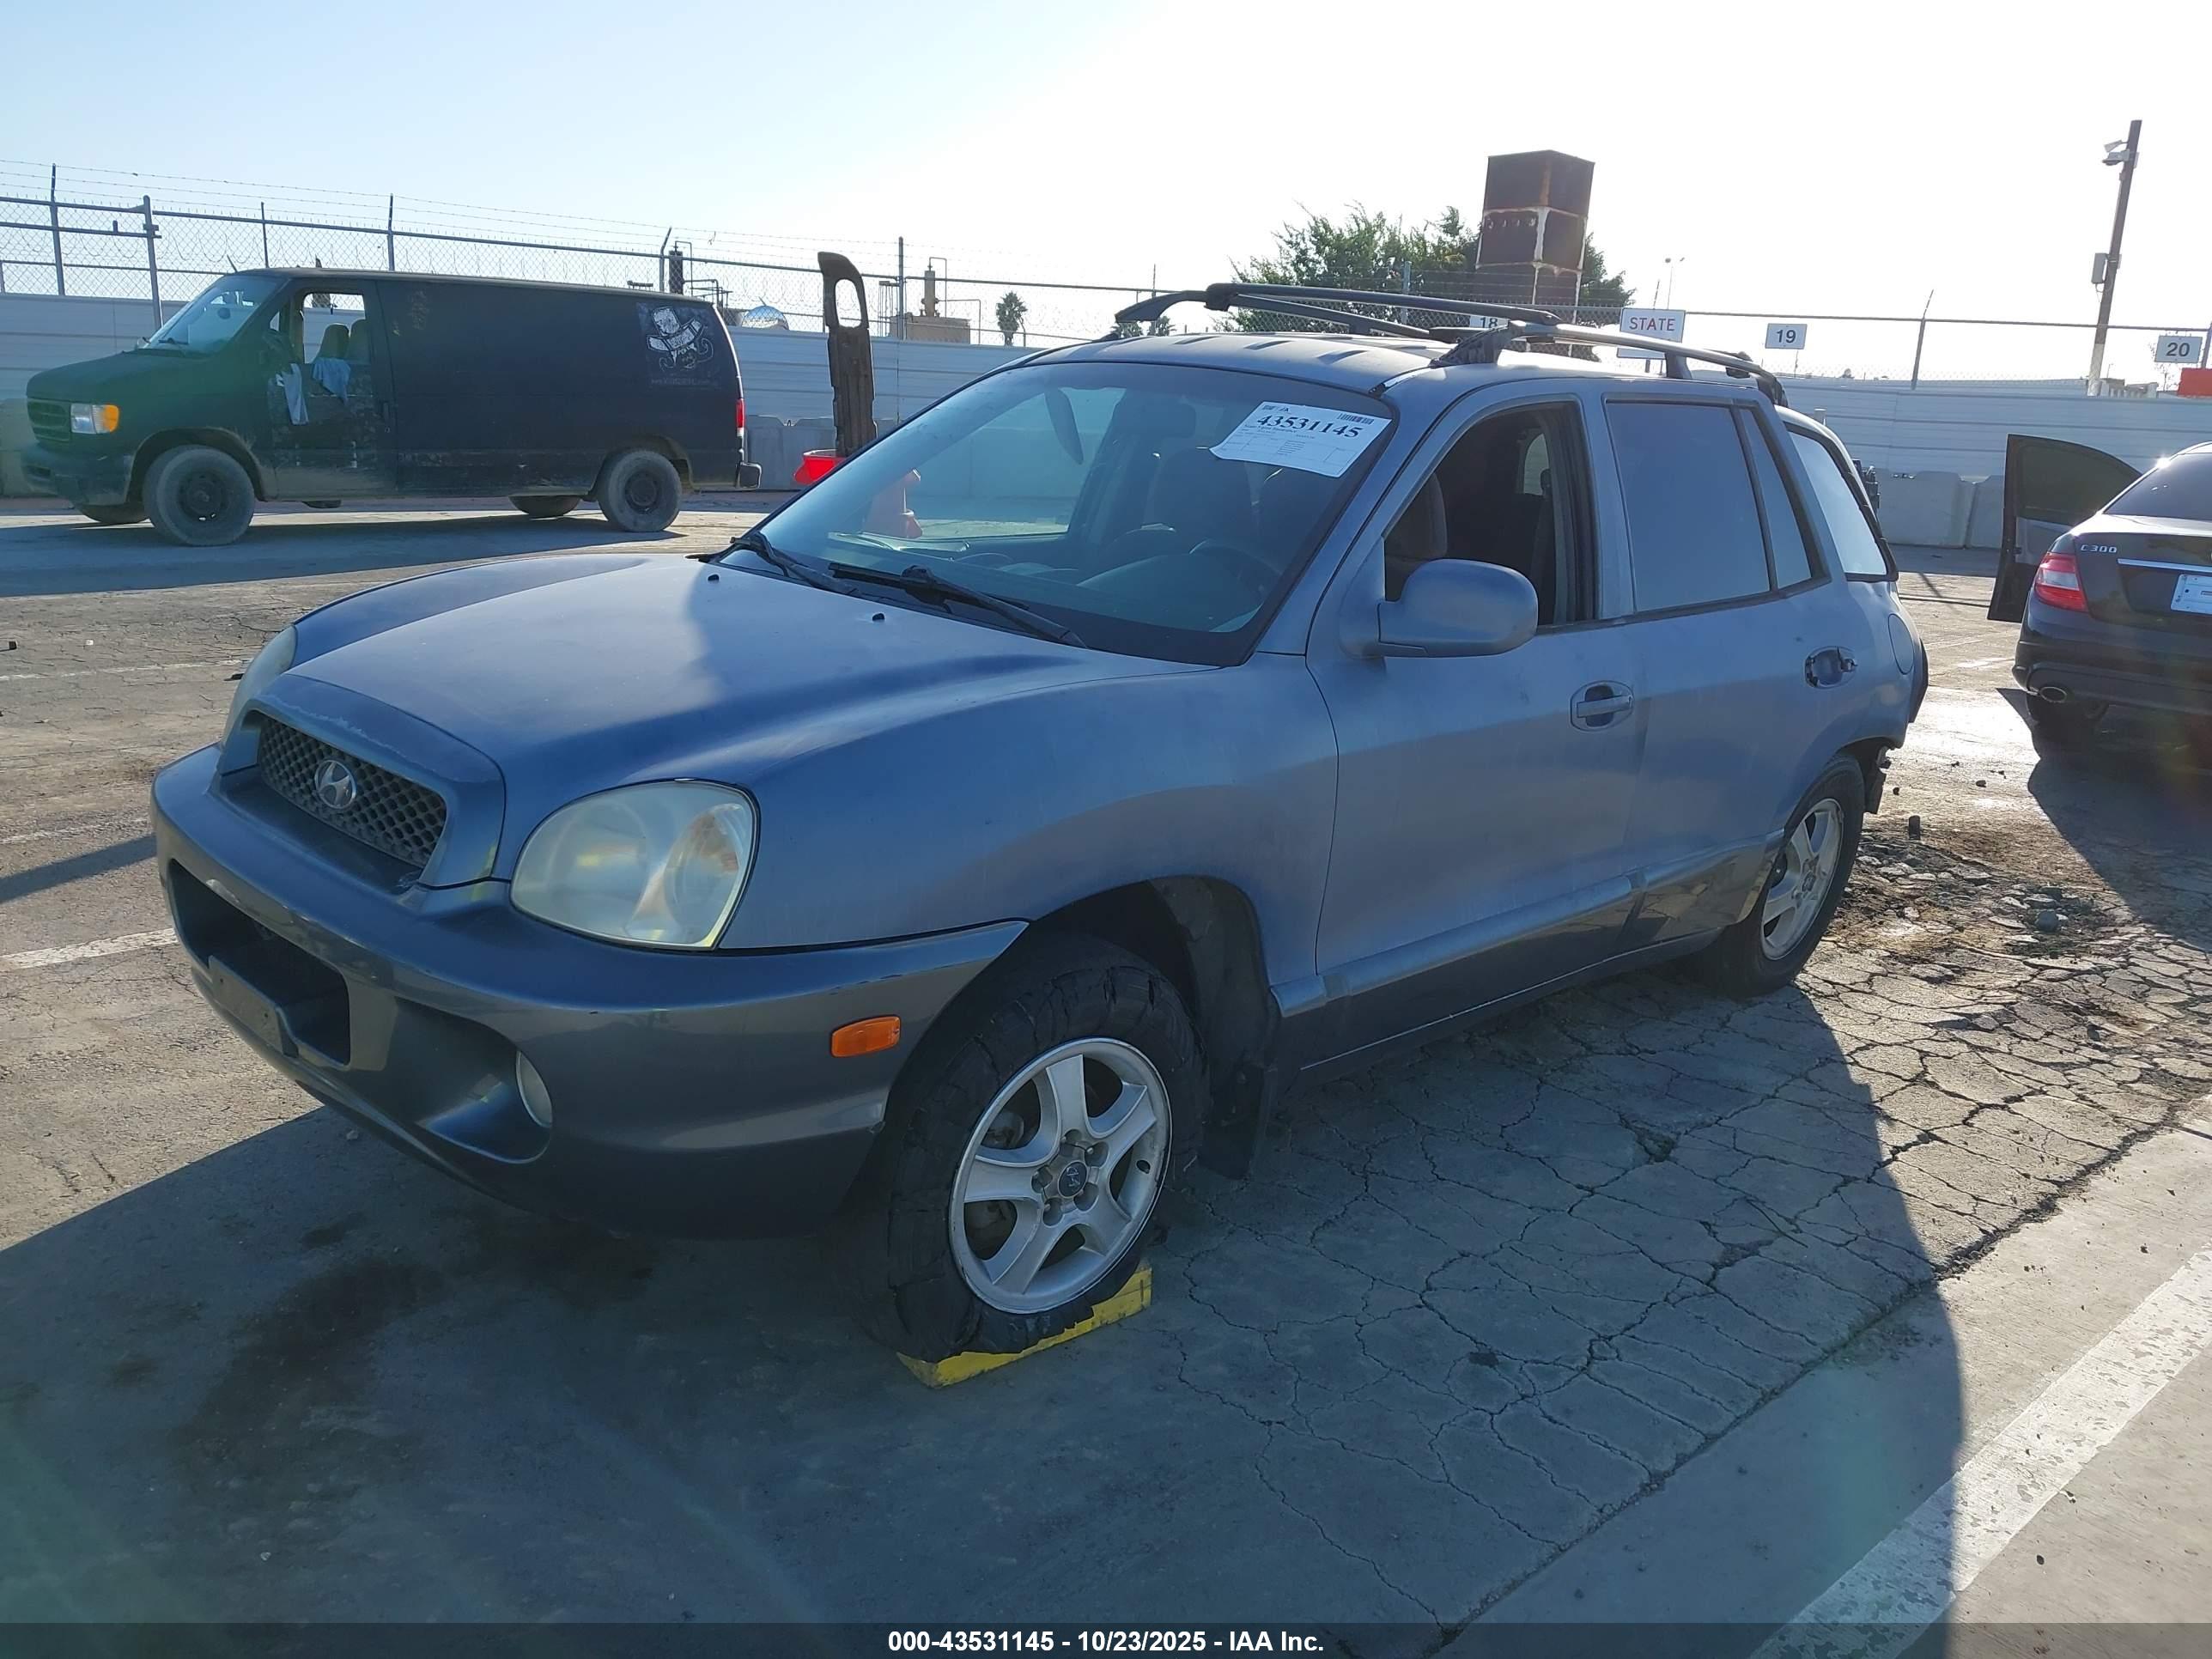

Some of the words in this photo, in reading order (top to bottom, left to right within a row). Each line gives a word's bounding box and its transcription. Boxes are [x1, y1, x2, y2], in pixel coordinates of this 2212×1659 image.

[1629, 317, 1675, 331] STATE
[1776, 329, 1796, 343] 19
[2166, 342, 2191, 357] 20
[1256, 414, 1364, 439] 43531145
